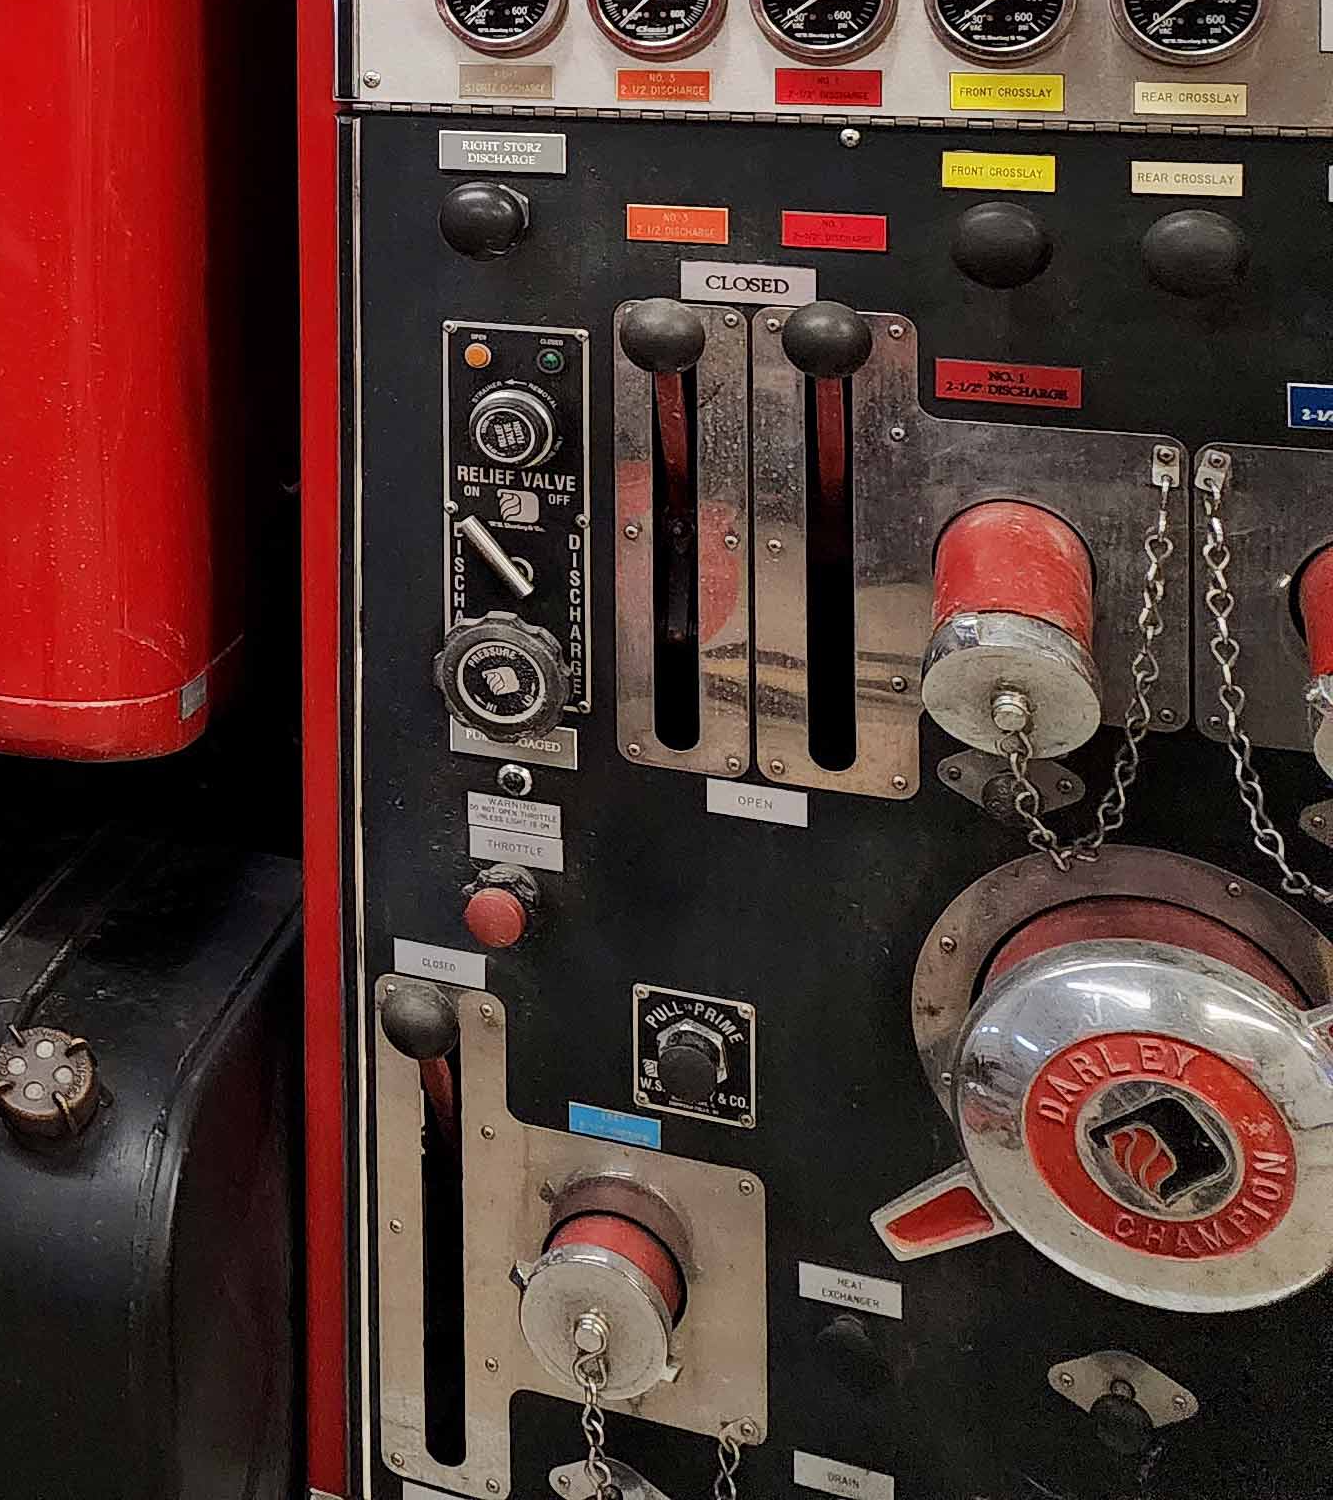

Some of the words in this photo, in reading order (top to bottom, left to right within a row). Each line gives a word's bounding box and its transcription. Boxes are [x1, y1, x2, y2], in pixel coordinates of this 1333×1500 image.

[512, 6, 527, 15] 600
[834, 11, 851, 20] 600
[1014, 12, 1033, 21] 600
[1153, 12, 1159, 21] 0
[1205, 15, 1226, 24] 600
[649, 73, 664, 82] NO.
[620, 85, 628, 95] 2
[651, 86, 706, 96] DISCHARGE
[820, 91, 870, 100] DISCHARGE
[960, 87, 993, 97] FRONT
[998, 88, 1053, 98] CROSSLAY
[1142, 92, 1172, 102] REAR
[1178, 93, 1239, 103] CROSSLAY
[462, 140, 500, 153] RIGHT
[503, 142, 542, 153] STORZ
[467, 153, 535, 165] DISCHARGE
[951, 166, 984, 176] FRONT
[989, 168, 1044, 178] CROSSLAY
[1137, 172, 1169, 182] REAR
[1173, 174, 1234, 184] CROSSLAY
[662, 212, 677, 221] NO.
[636, 224, 645, 235] 2
[665, 227, 717, 238] DISCHARGE
[705, 274, 790, 294] CLOSED
[988, 371, 1013, 382] NO.
[1019, 373, 1025, 383] 1
[471, 381, 503, 404] STRAINER
[527, 383, 558, 409] REMOVAL
[945, 381, 983, 393] 2-1/2"
[987, 384, 1069, 400] DISCHARGE
[493, 424, 507, 448] RELIEF
[503, 422, 516, 446] VALVE
[457, 465, 516, 485] RELIEF
[521, 471, 576, 492] VALVE
[464, 485, 480, 497] ON
[548, 494, 570, 506] OFF
[569, 534, 582, 694] DISCHARGE
[467, 646, 517, 668] PRESSURE
[486, 703, 497, 713] HI
[488, 798, 537, 811] WARNING
[737, 795, 773, 810] OPEN
[470, 803, 479, 811] DO
[499, 808, 517, 817] OPEN
[520, 811, 557, 822] THROTTLE
[477, 813, 503, 823] UNLESS
[505, 817, 527, 826] LIGHT
[487, 839, 543, 857] THROTTLE
[422, 958, 456, 972] CLOSED
[645, 1001, 684, 1029] PULL
[693, 1002, 745, 1044] PRIME
[1037, 1038, 1199, 1125] DARLEY
[640, 1077, 666, 1092] W.S.
[717, 1093, 727, 1105] &
[729, 1095, 750, 1109] CO.
[1113, 1150, 1288, 1255] CHAMPION
[837, 1277, 863, 1290] HEAT
[821, 1288, 880, 1309] EXCHANGER
[827, 1472, 860, 1489] DRAIN
